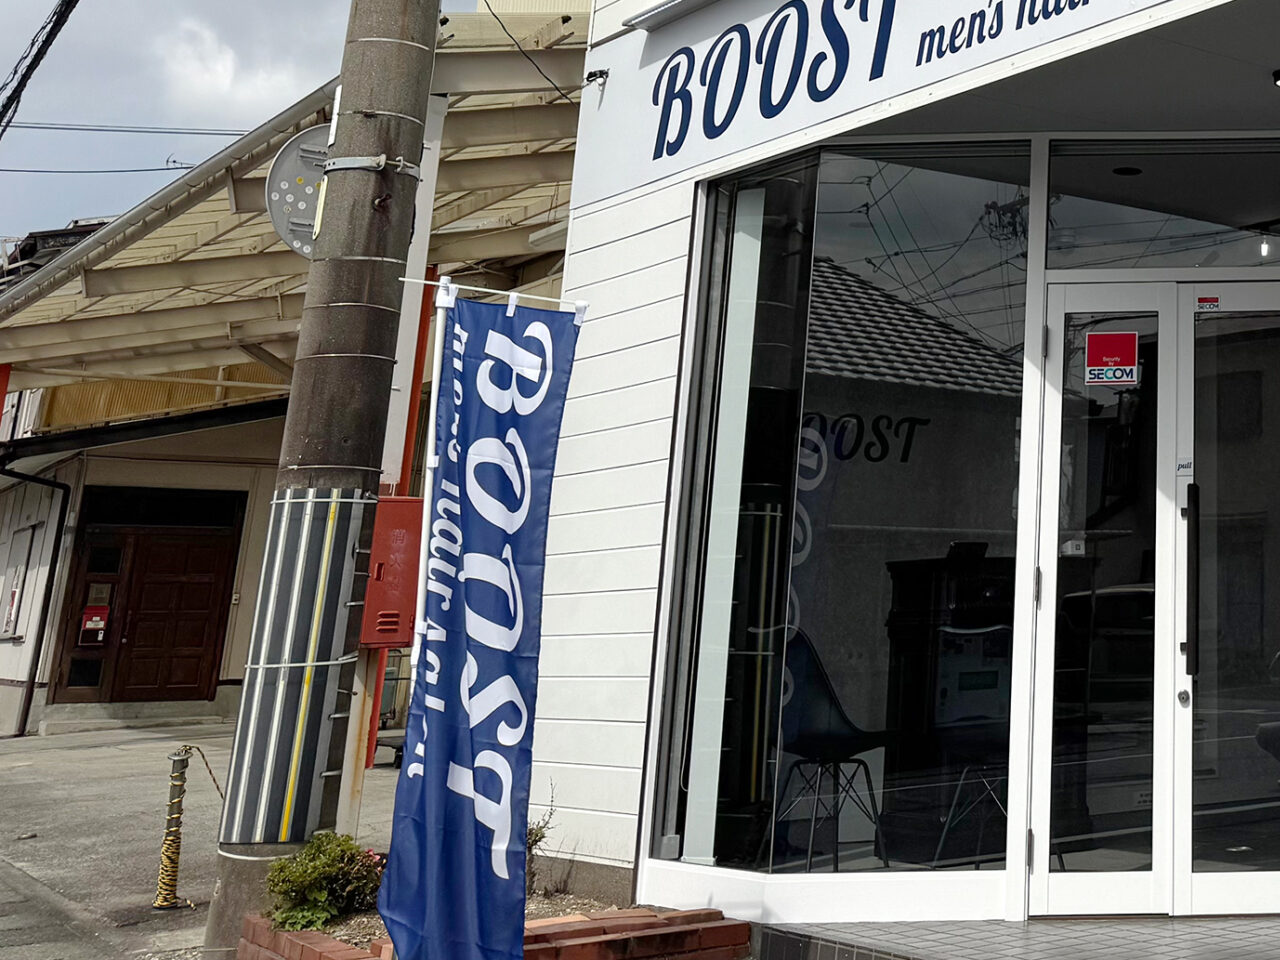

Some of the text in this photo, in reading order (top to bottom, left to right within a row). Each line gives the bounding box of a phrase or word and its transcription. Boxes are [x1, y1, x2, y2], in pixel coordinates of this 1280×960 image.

[1089, 368, 1134, 380] SECOM
[1177, 461, 1192, 471] pull
[447, 319, 553, 880] BOOST
